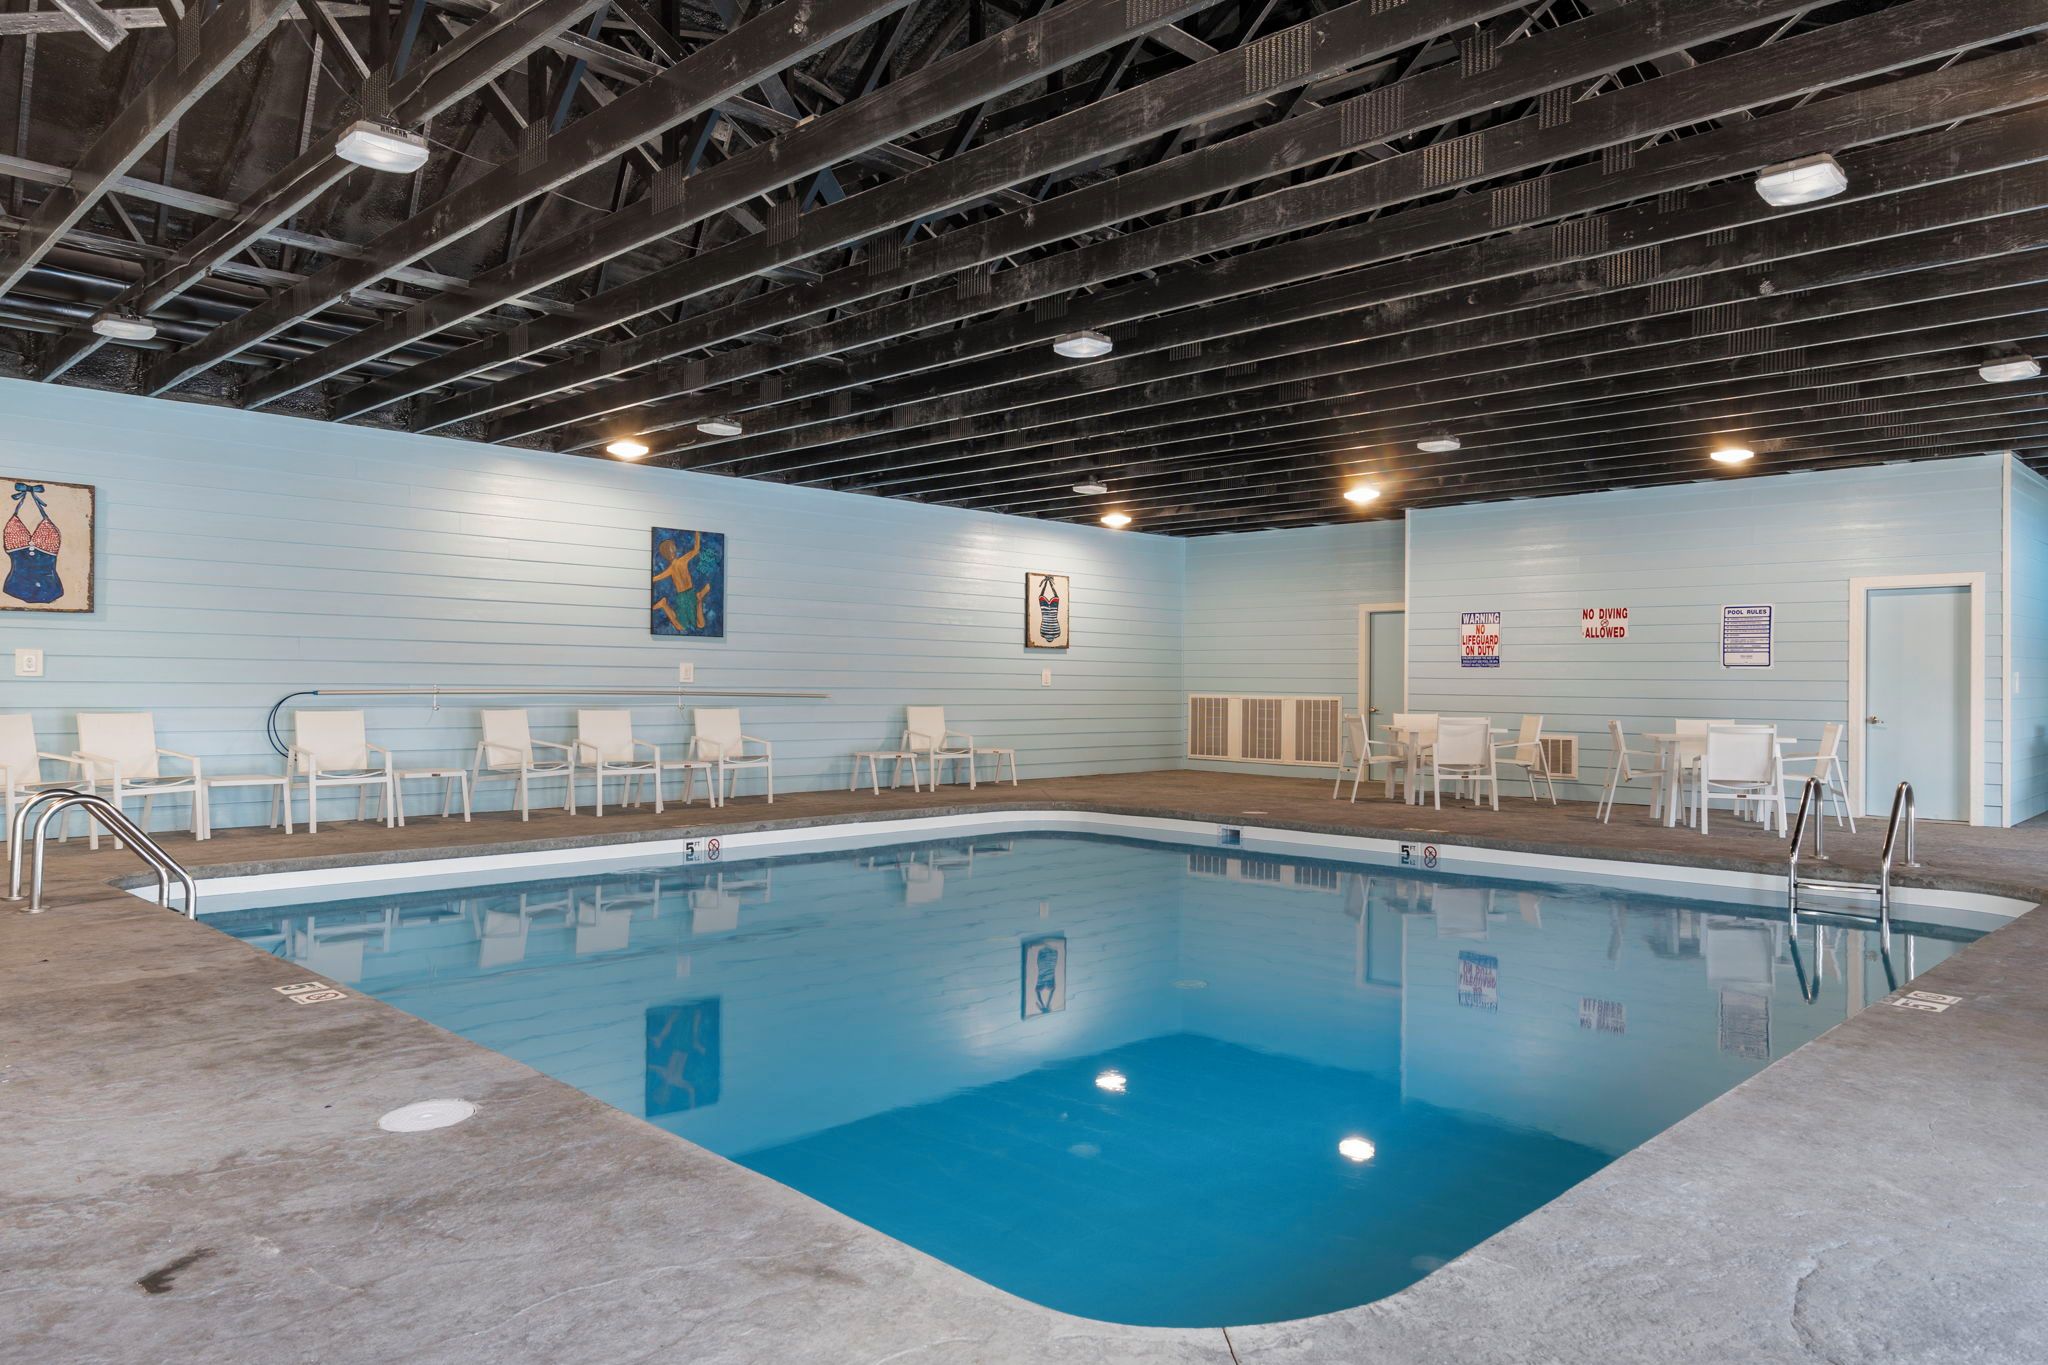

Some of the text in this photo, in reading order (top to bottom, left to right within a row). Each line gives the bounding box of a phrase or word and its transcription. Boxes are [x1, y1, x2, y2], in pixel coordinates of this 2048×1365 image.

[1462, 612, 1499, 624] WARNING
[1582, 607, 1628, 620] NO DIVING
[1475, 624, 1486, 635] NO
[1584, 626, 1625, 638] ALLOWED
[1462, 635, 1499, 645] LIFEGUARD
[1465, 645, 1495, 655] ON DUTY
[686, 842, 694, 853] 5
[1401, 845, 1410, 856] 5
